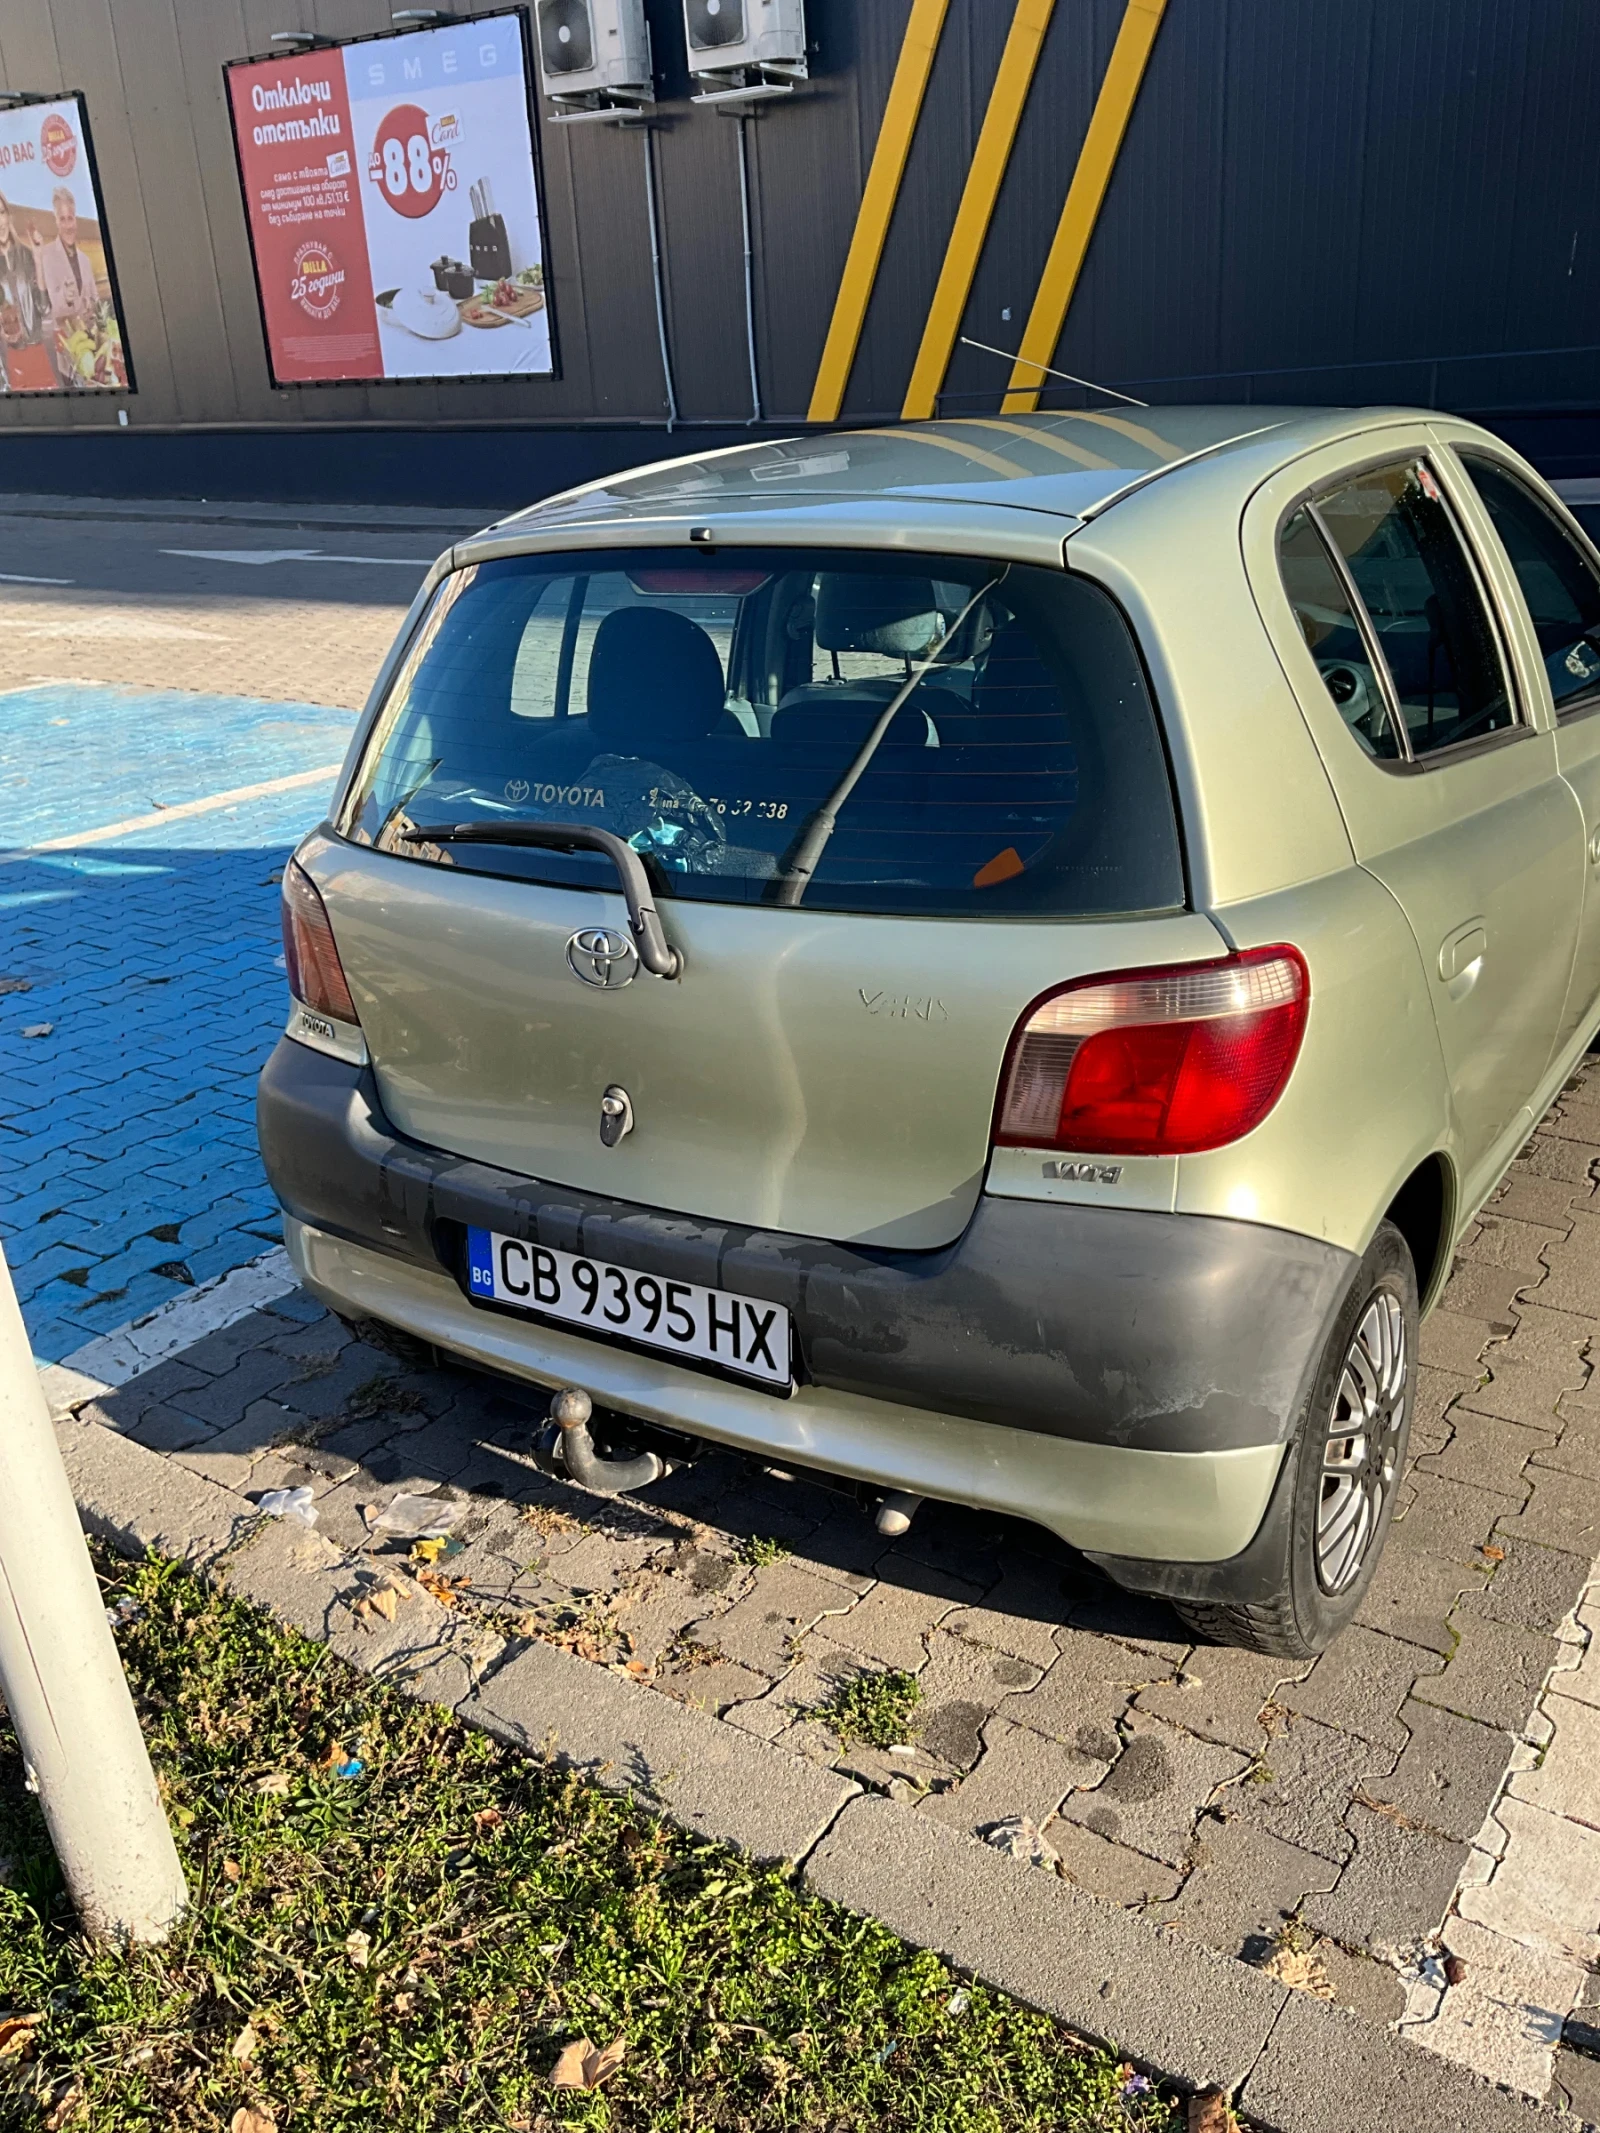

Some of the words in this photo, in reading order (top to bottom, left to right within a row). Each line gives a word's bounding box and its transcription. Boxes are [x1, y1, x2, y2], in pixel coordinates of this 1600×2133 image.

[368, 44, 497, 85] SMEG
[252, 77, 331, 111] Отключи
[253, 108, 340, 145] отстъпки
[431, 119, 459, 144] Card
[12, 141, 35, 162] ВАС
[273, 172, 291, 182] само
[293, 171, 298, 180] с
[299, 166, 328, 178] твоята
[312, 183, 320, 192] на
[261, 203, 272, 212] от
[272, 200, 302, 211] минимум
[303, 194, 315, 206] 100
[268, 213, 281, 226] без
[314, 210, 323, 219] на
[323, 205, 346, 218] точки
[303, 260, 327, 274] BILLA
[291, 275, 307, 300] 25
[308, 269, 345, 297] години
[534, 783, 605, 808] TOYOTA
[299, 1011, 335, 1039] TOYOTA
[472, 1266, 492, 1286] BG
[499, 1239, 561, 1305] CB
[571, 1259, 696, 1342] 9395
[707, 1292, 778, 1372] HX
